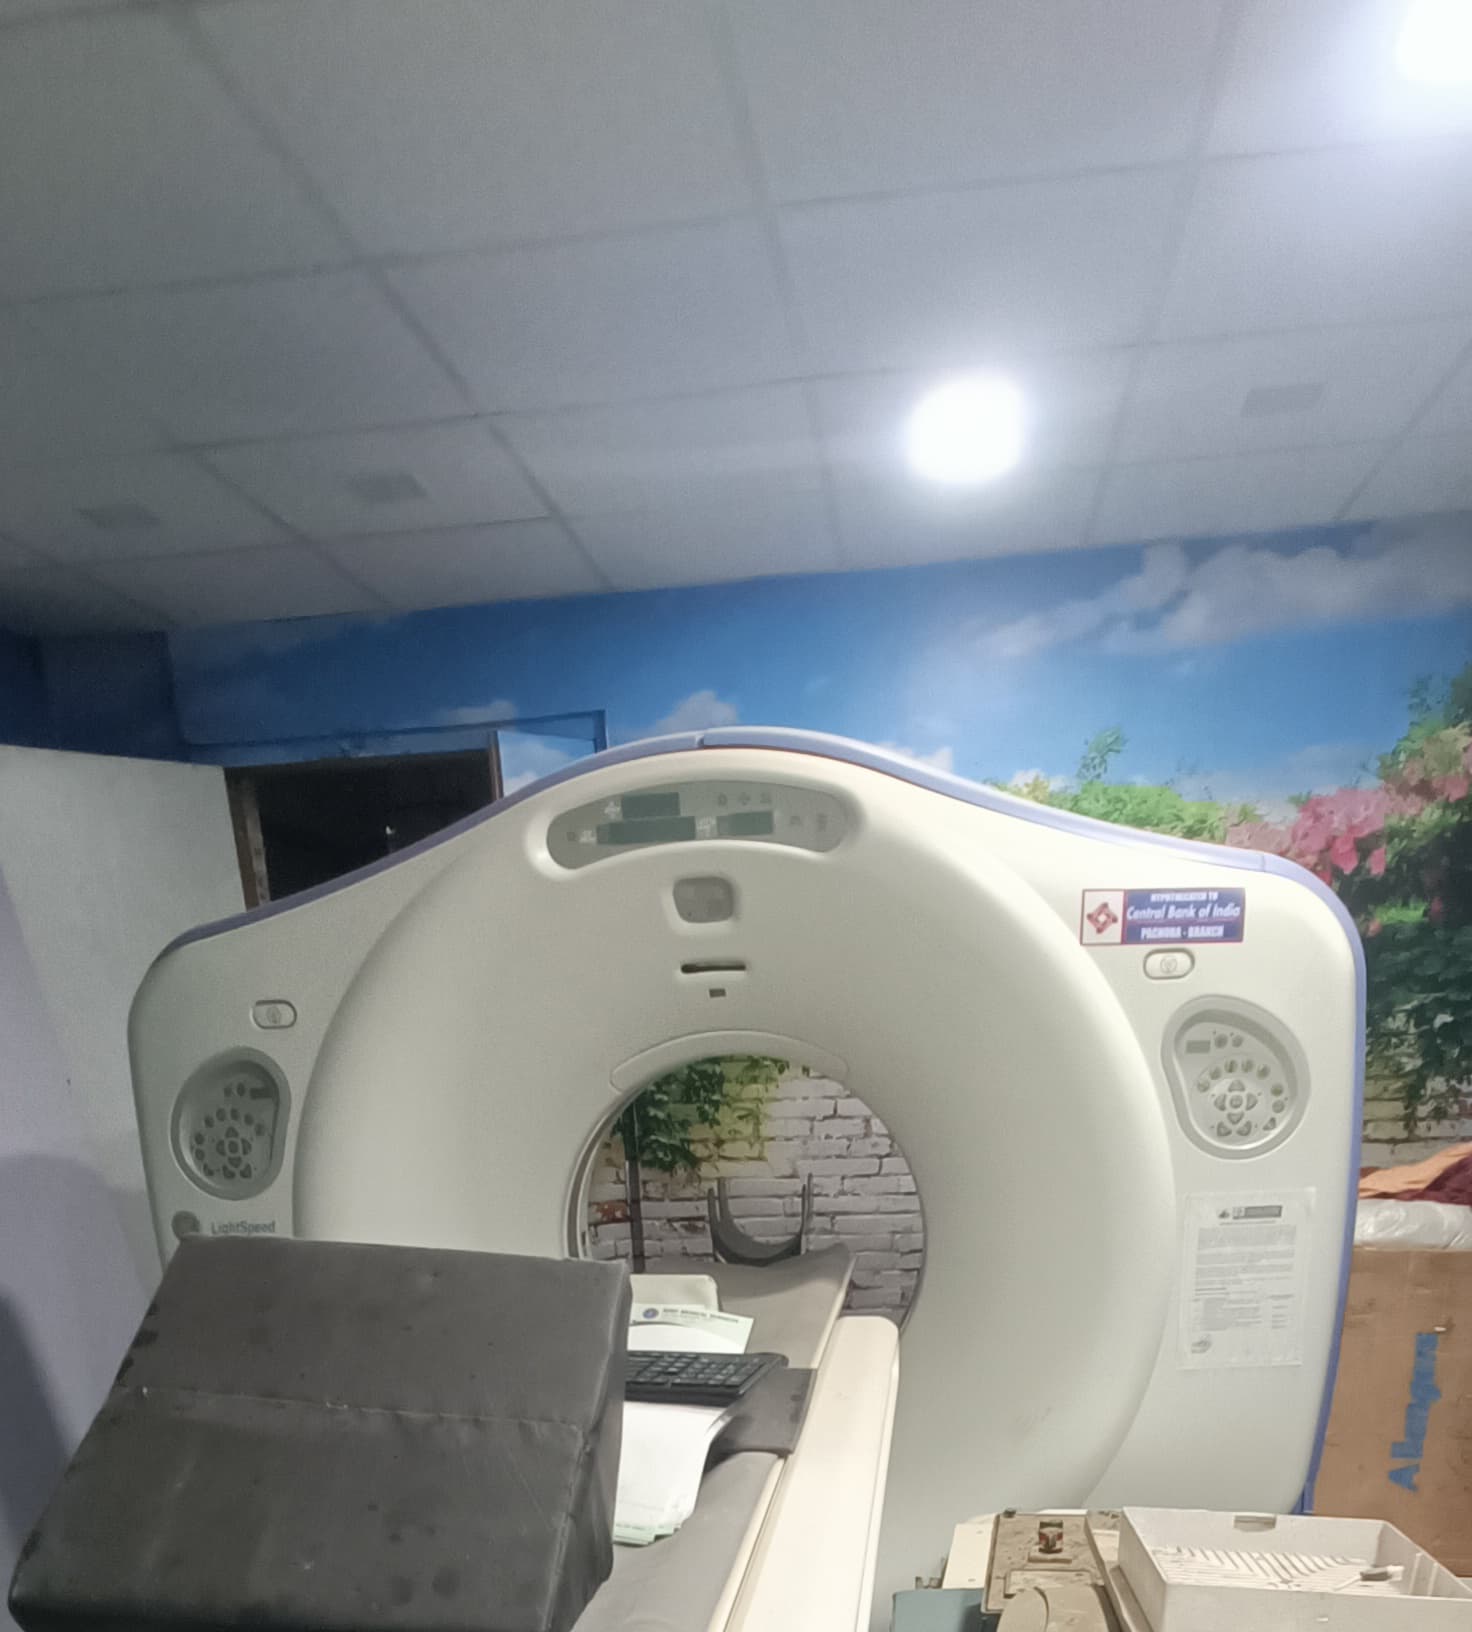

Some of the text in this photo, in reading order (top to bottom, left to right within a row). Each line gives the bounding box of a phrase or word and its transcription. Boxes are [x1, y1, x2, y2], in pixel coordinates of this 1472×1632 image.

[1126, 902, 1240, 920] Central Bank of India
[1188, 925, 1224, 938] BRANCH
[211, 1220, 276, 1235] LightSpeed
